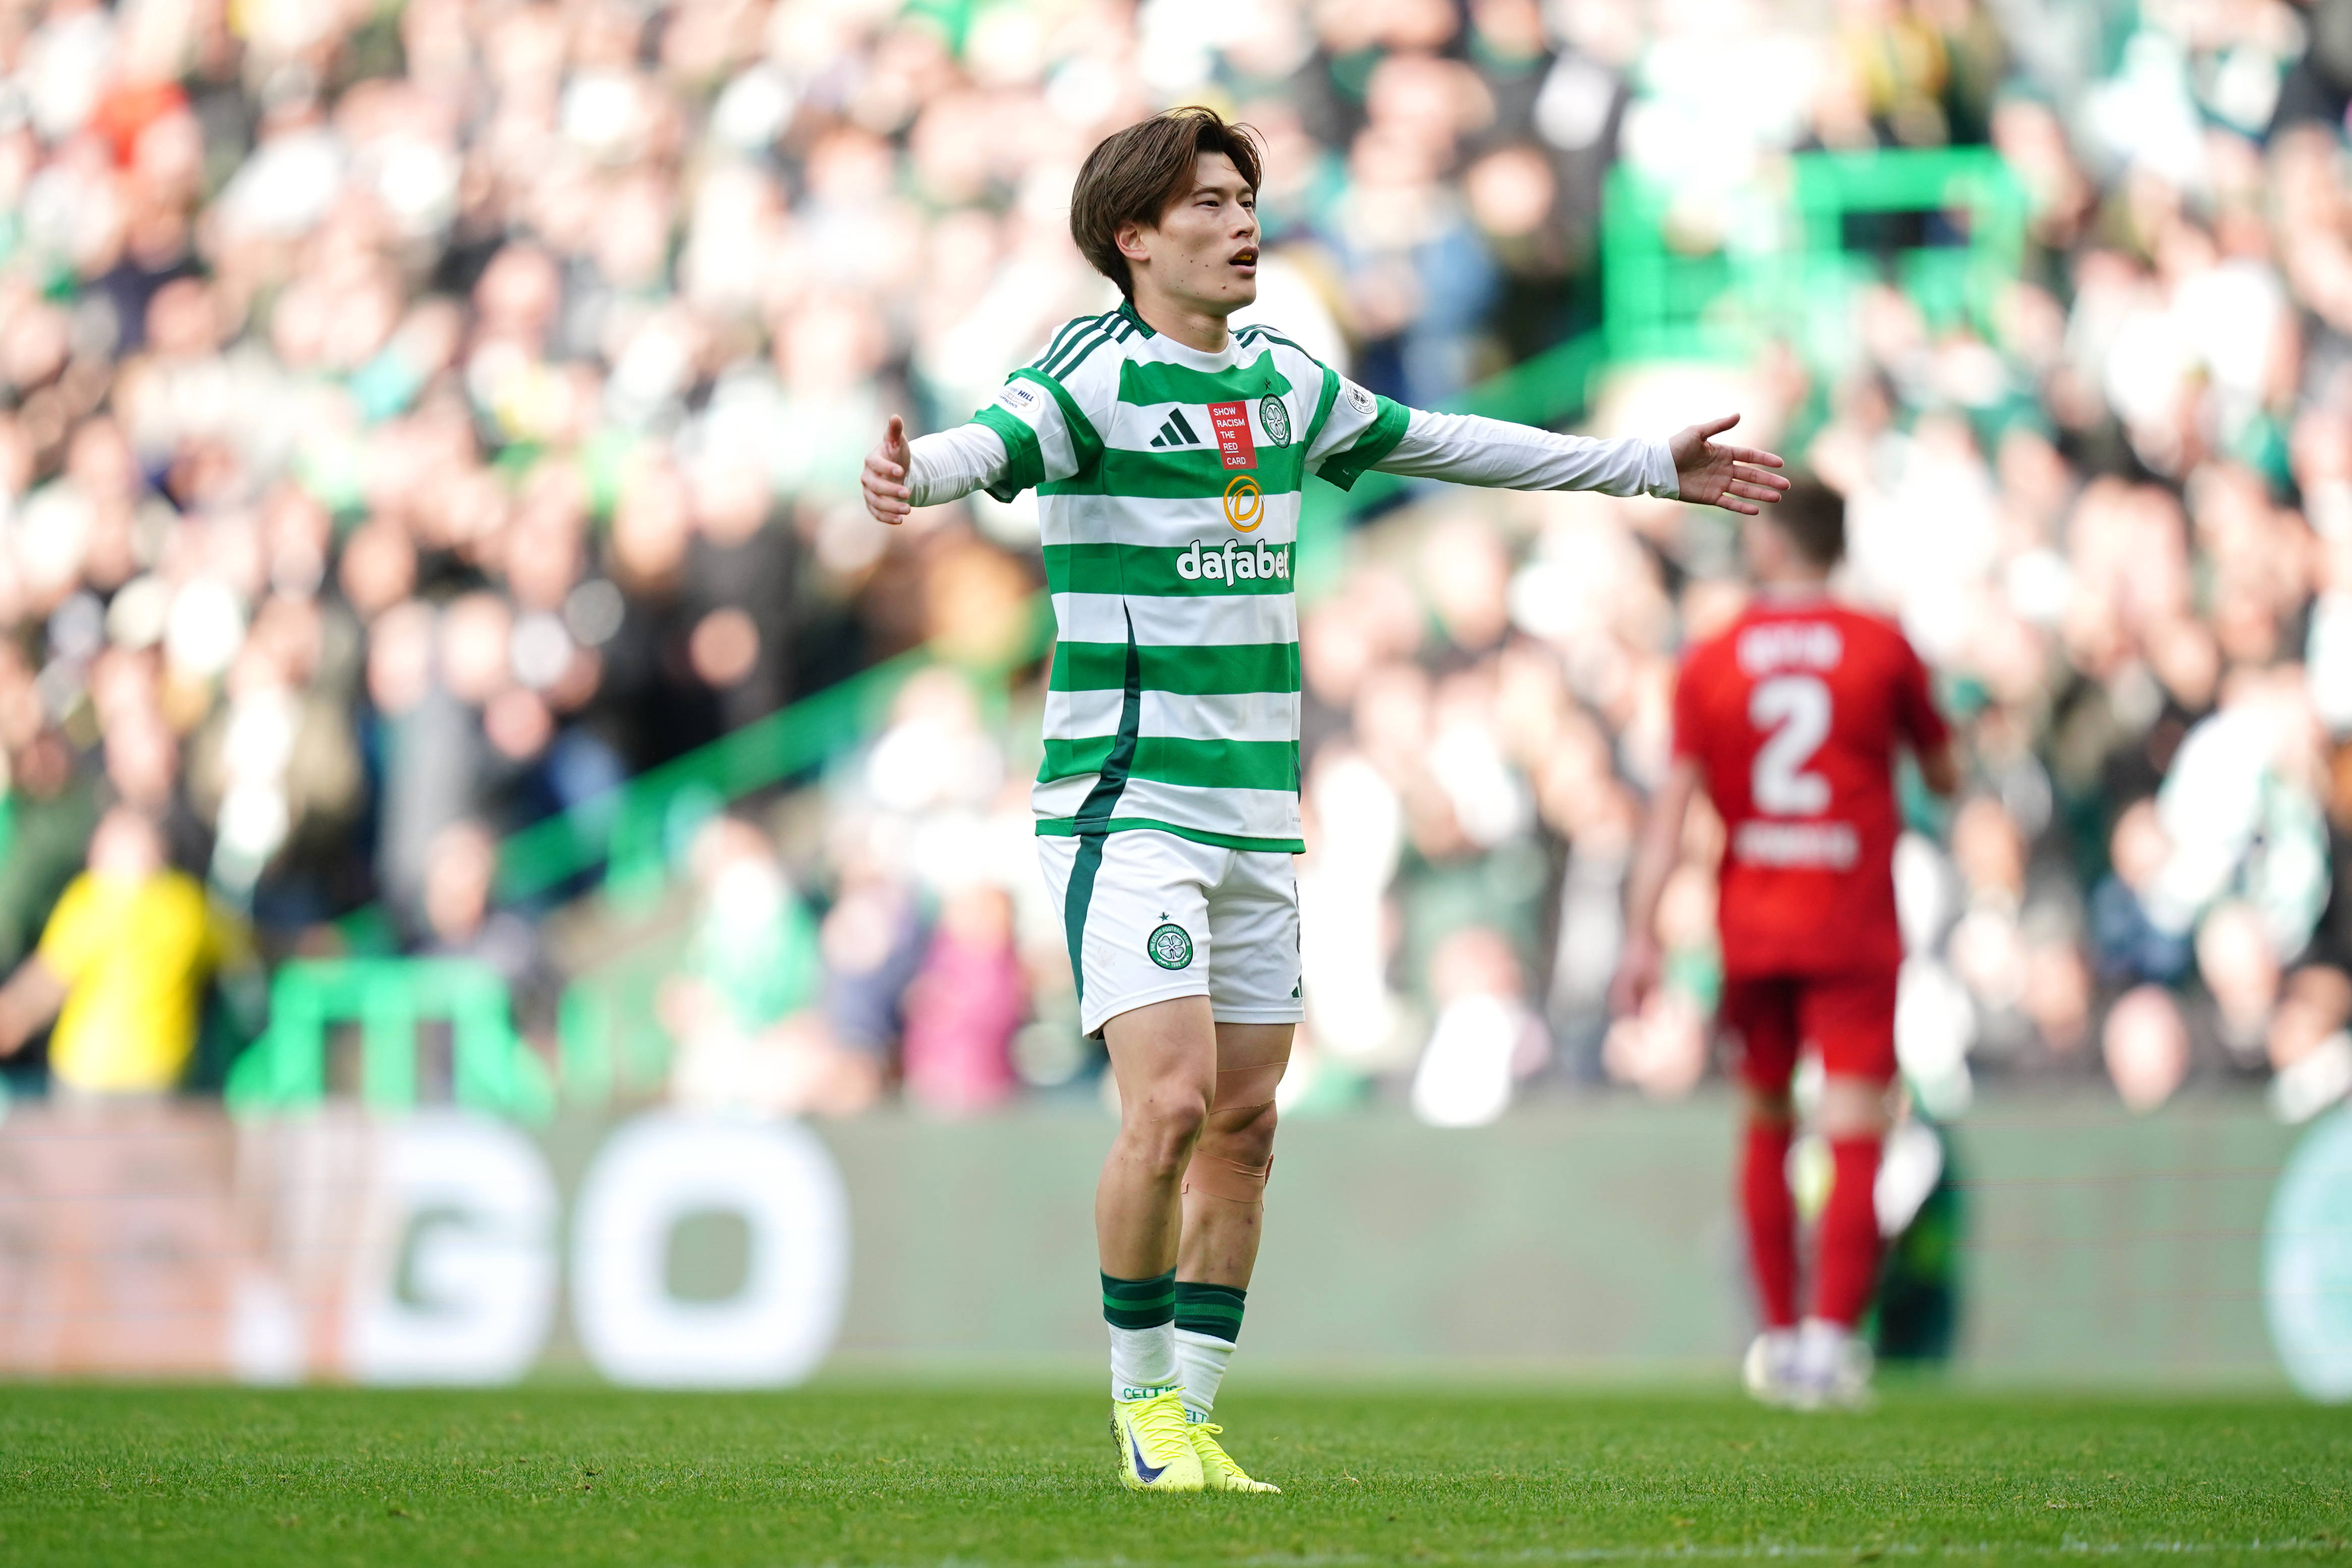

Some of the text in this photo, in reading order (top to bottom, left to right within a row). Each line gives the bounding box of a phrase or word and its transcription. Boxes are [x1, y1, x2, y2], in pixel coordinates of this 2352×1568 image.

[1018, 390, 1034, 402] HILL
[1213, 407, 1236, 416] SHOW
[1216, 418, 1246, 427] RACISM
[1220, 430, 1236, 439] THE
[1223, 442, 1238, 451] RED
[1226, 457, 1246, 465] CARD
[1177, 538, 1290, 587] dafabet
[1749, 673, 1832, 815] 2
